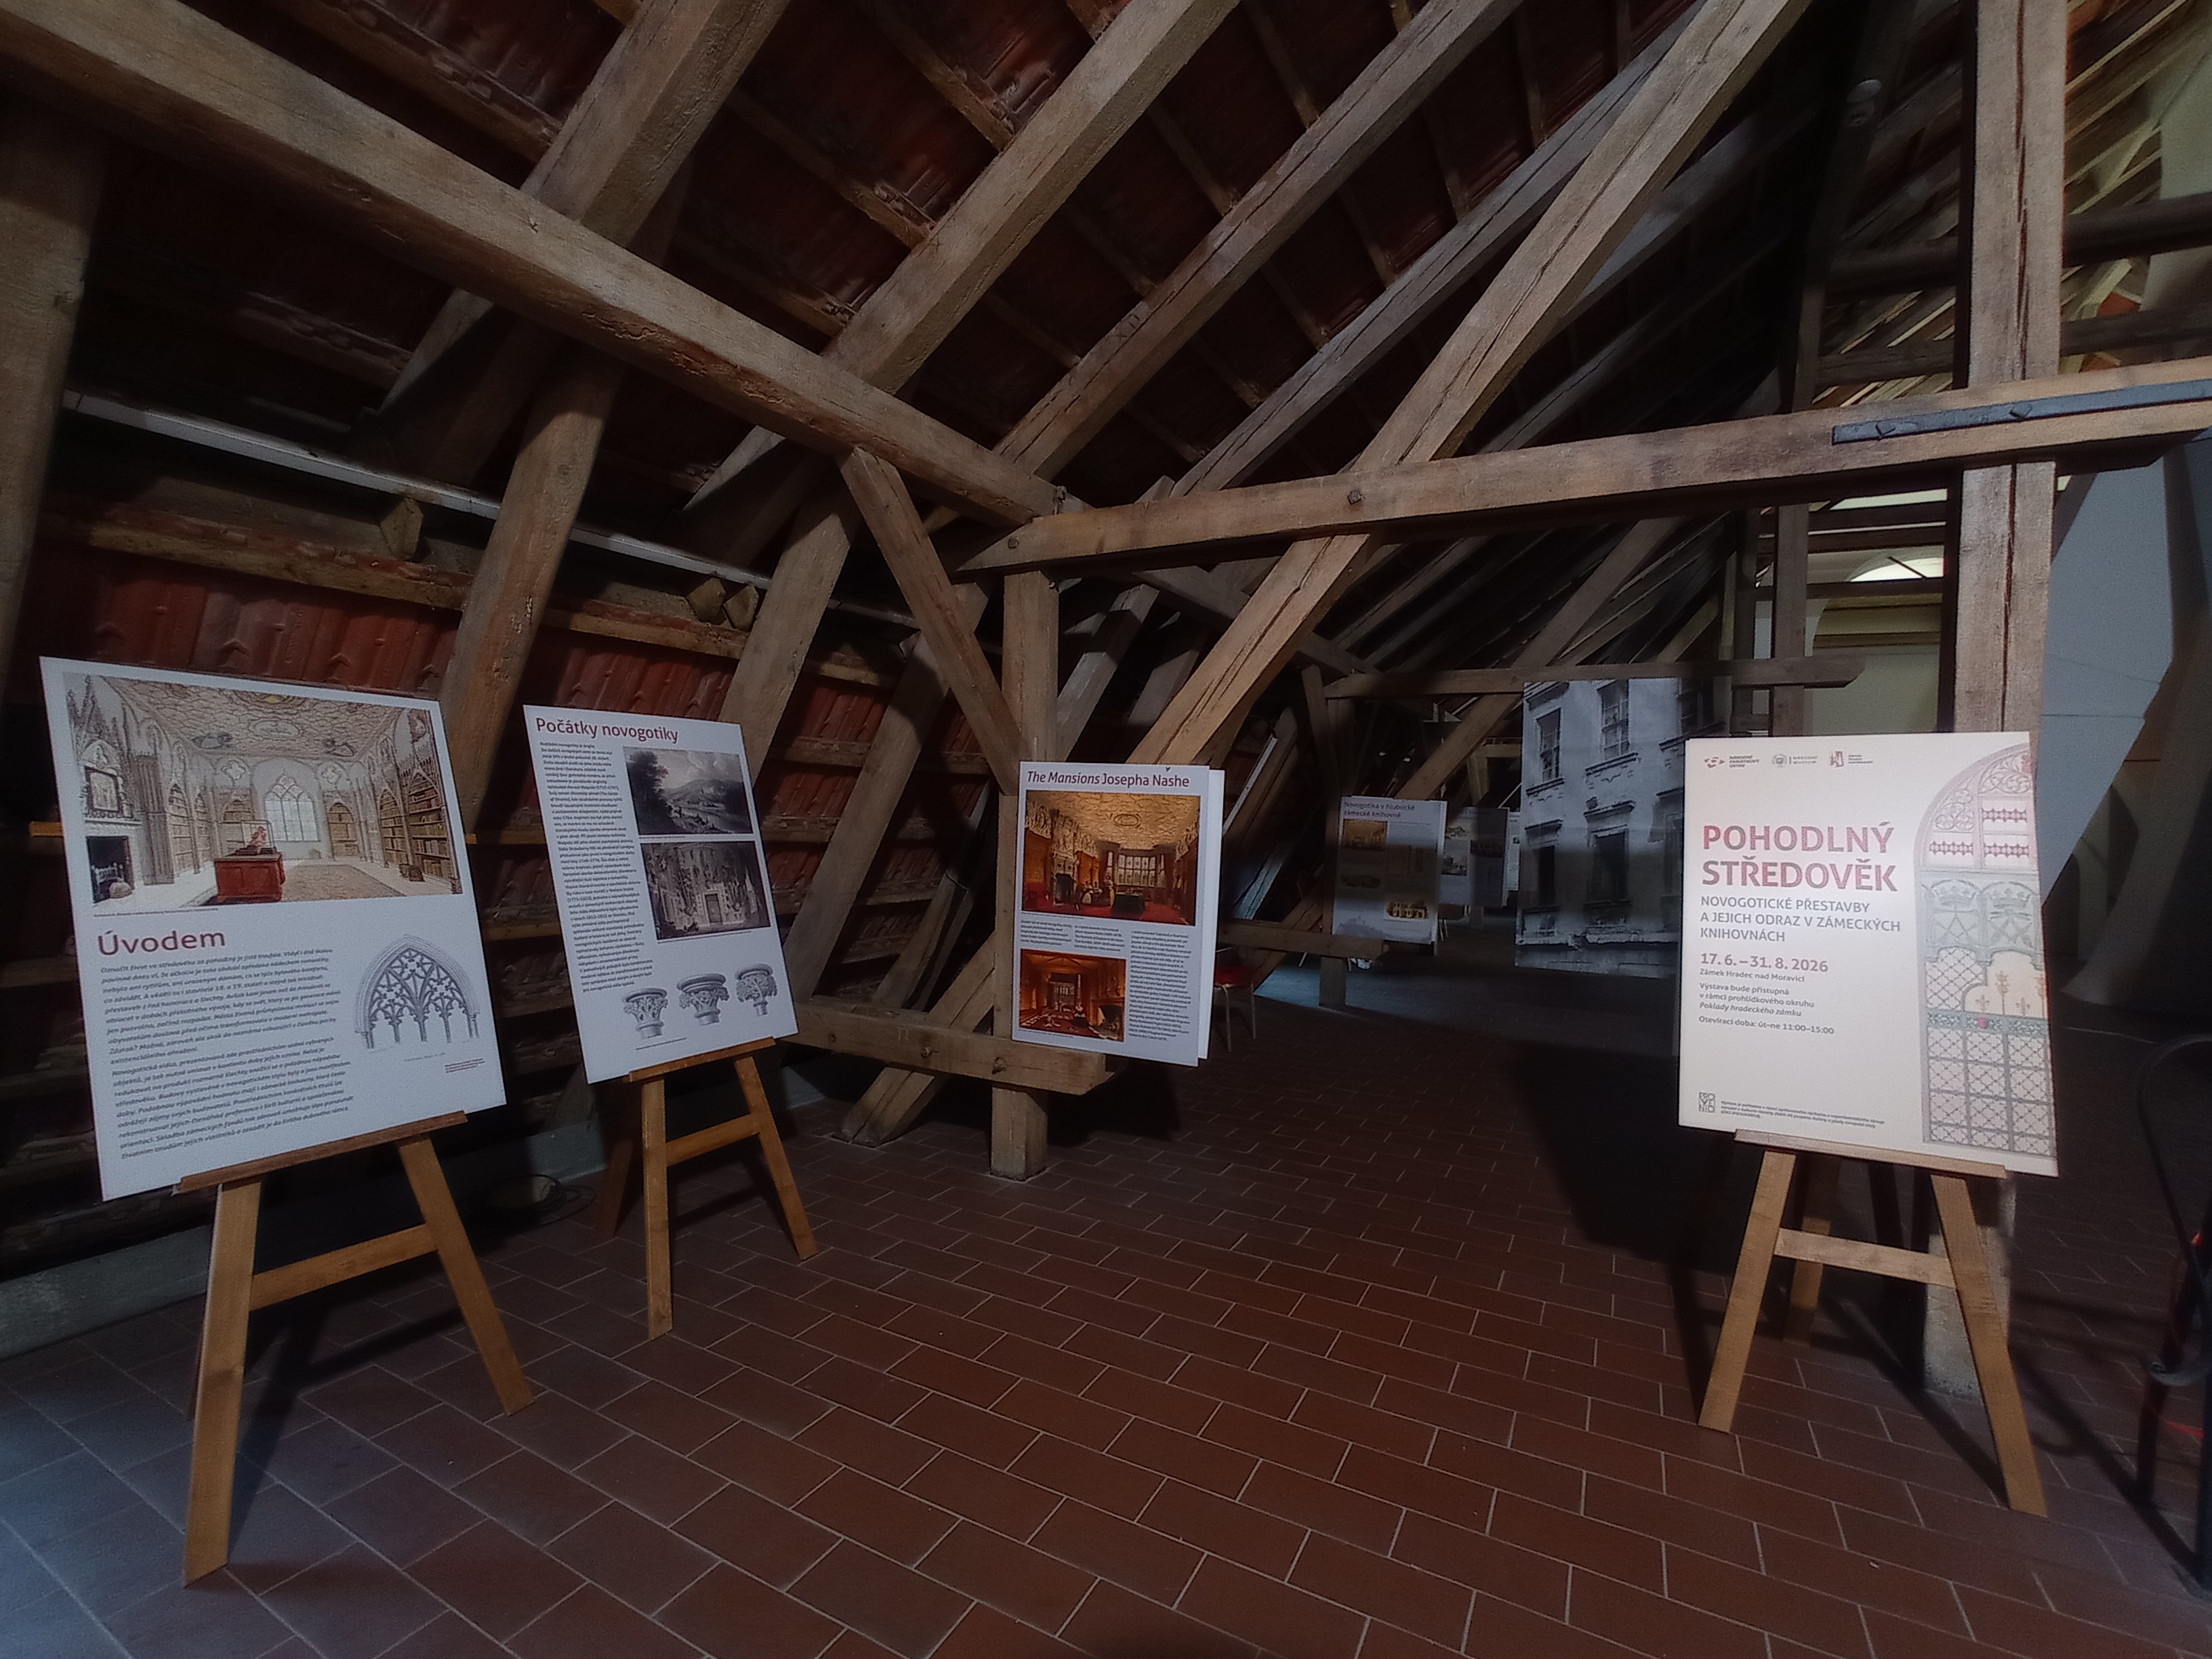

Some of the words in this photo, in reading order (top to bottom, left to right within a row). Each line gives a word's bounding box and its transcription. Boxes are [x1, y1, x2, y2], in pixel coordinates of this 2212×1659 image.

[535, 717, 598, 739] Počátky
[602, 724, 678, 744] novogotiky
[1027, 771, 1046, 783] The
[1048, 771, 1100, 785] Mansions
[1102, 773, 1149, 789] Josepha
[1152, 775, 1189, 787] Nashe
[1703, 821, 1895, 854] POHODLNÝ
[1702, 855, 1898, 892] STŘEDOVĚK
[1700, 895, 1793, 910] NOVOGOTICKÉ
[1796, 899, 1870, 913] PŘESTAVBY
[1700, 912, 1709, 922] A
[1711, 912, 1751, 924] JEJICH
[1755, 914, 1801, 926] ODRAZ
[1804, 916, 1813, 927] V
[1816, 916, 1901, 933] ZÁMECKÝCH
[97, 929, 226, 956] Úvodem
[1700, 927, 1786, 942] KNIHOVNÁCH
[1700, 968, 1725, 977] Zámek
[1726, 970, 1753, 979] Hradec
[1791, 958, 1828, 972] 2026
[1699, 982, 1729, 991] Výstava
[1730, 984, 1750, 993] bude
[1752, 985, 1789, 996] přístupná
[1705, 992, 1727, 1001] rámci
[1728, 994, 1784, 1005] prohlídkového
[1786, 1000, 1814, 1008] okruhu
[1699, 1002, 1729, 1012] Poklady
[1730, 1005, 1774, 1015] hradeckého
[1776, 1007, 1802, 1017] zámku
[1735, 1019, 1757, 1027] doba:
[1782, 1023, 1835, 1034] 11:00–15:00
